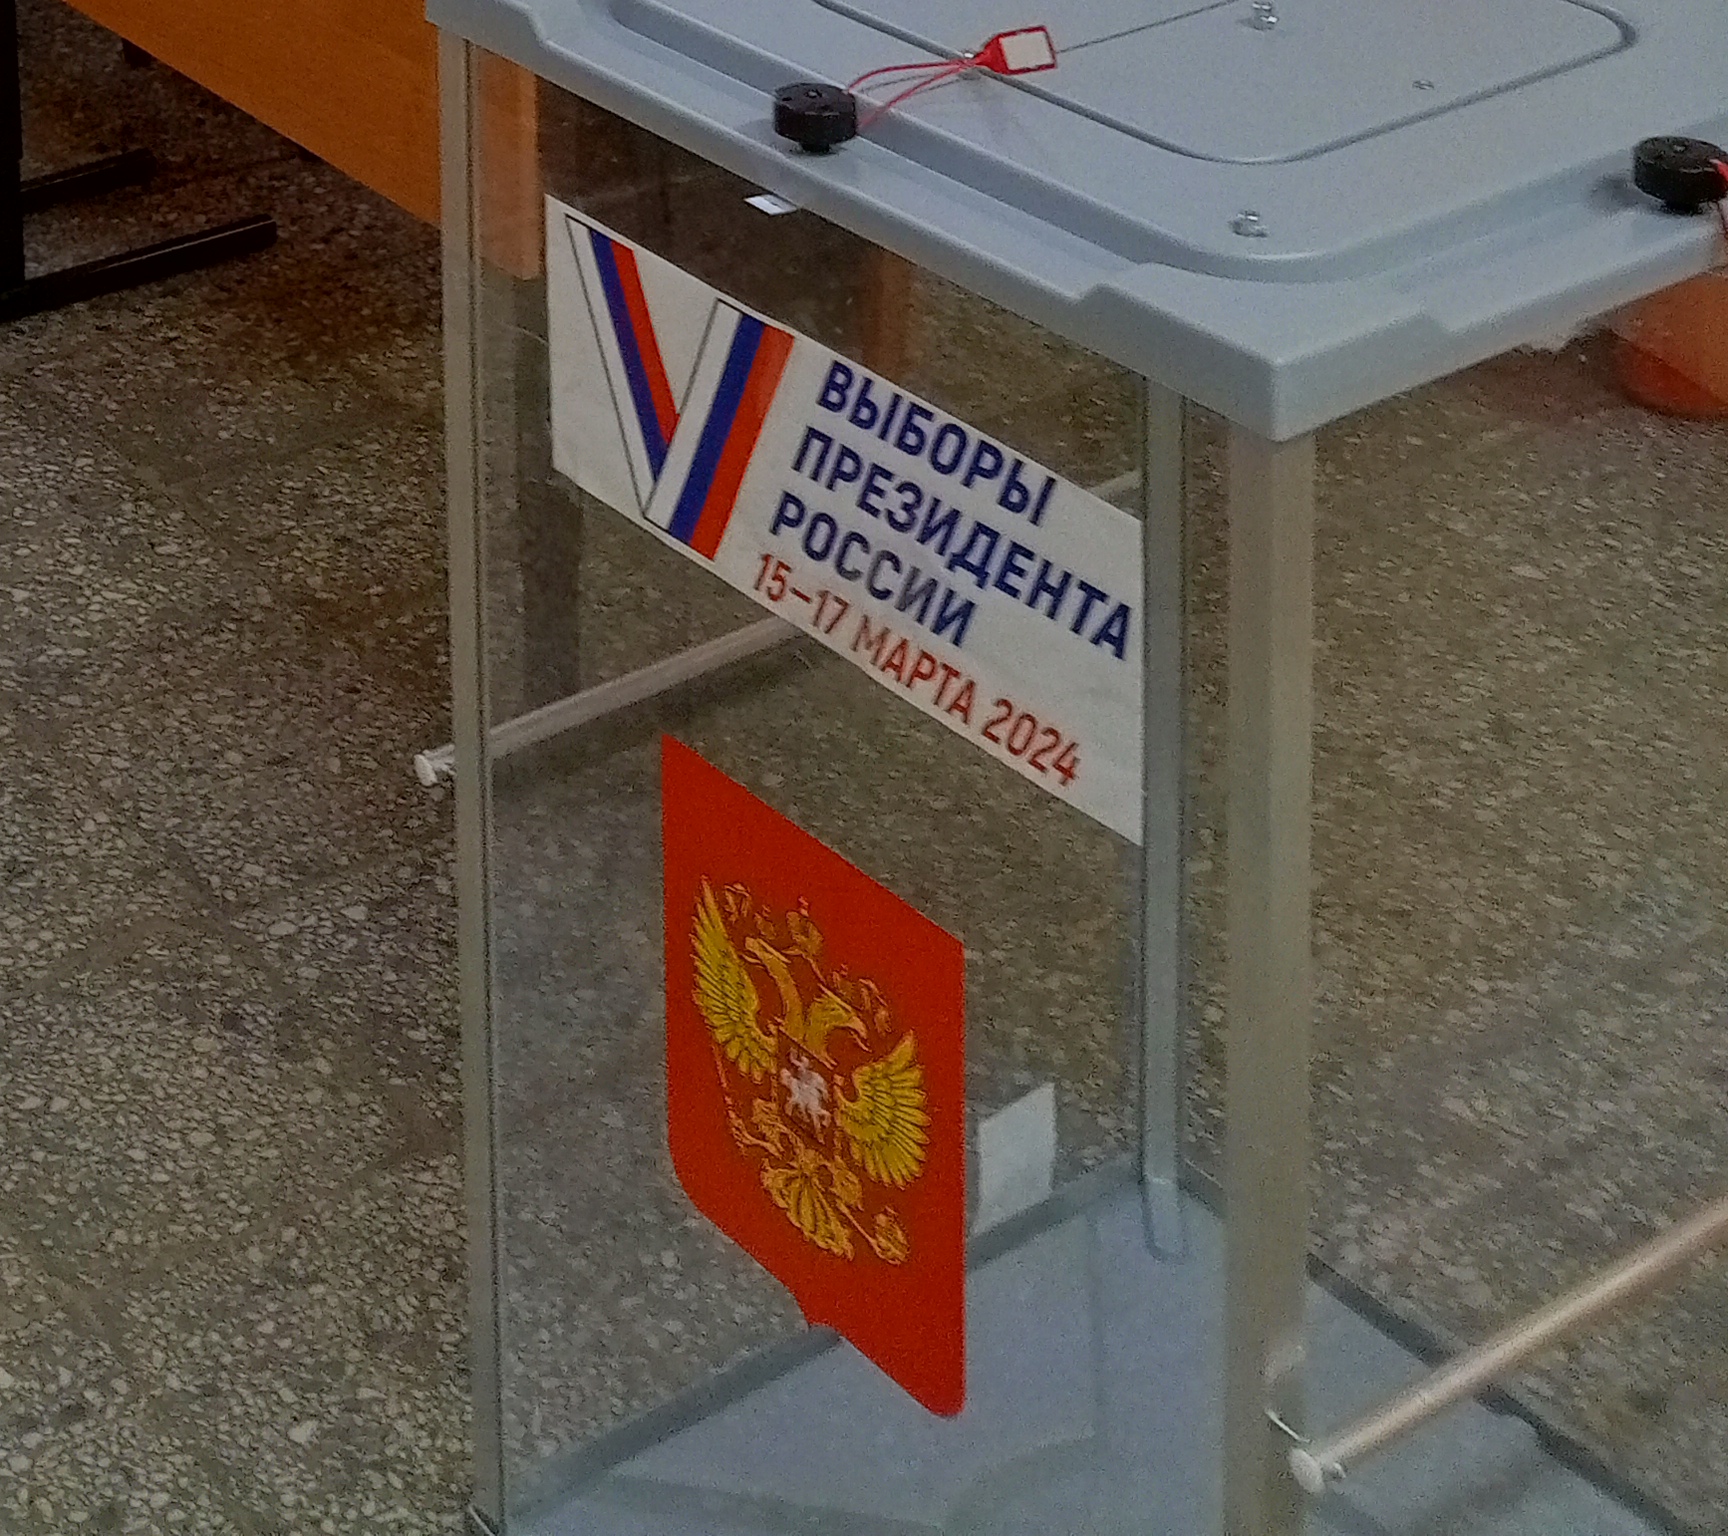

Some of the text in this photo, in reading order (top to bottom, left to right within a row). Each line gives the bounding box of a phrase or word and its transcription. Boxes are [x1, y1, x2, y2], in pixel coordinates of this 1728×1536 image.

[816, 359, 1057, 527] ВЫБОРЫ
[769, 490, 978, 647] РОССИИ
[790, 425, 1133, 661] ПРЕЗИДЕНТА
[852, 612, 979, 726] МАРТА
[981, 697, 1081, 787] 2024
